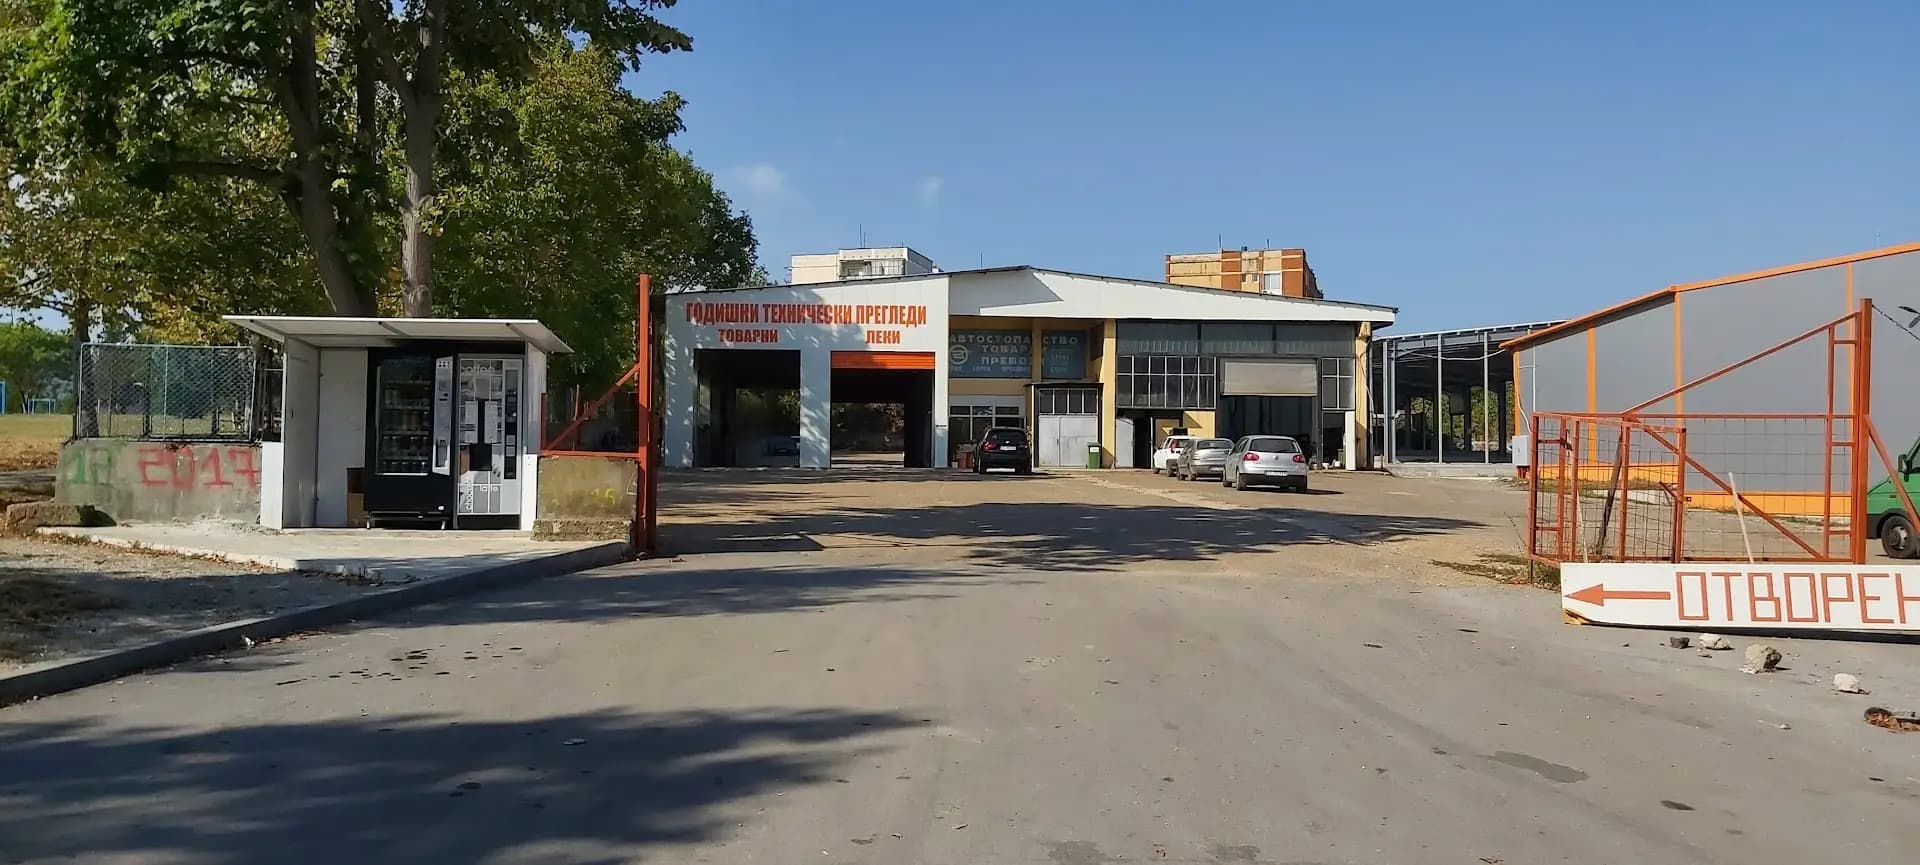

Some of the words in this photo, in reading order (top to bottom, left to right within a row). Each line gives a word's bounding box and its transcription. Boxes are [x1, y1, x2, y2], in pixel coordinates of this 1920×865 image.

[686, 303, 759, 325] ГОДИШНИ
[762, 304, 852, 325] ТЕХНИЧЕСКИ
[856, 305, 927, 328] ПРЕГЛЕДИ
[718, 329, 778, 343] ТОВАРНИ
[865, 330, 900, 344] ЛЕКИ
[137, 446, 261, 489] 2017
[1675, 571, 1920, 625] ОТВОРЕН
